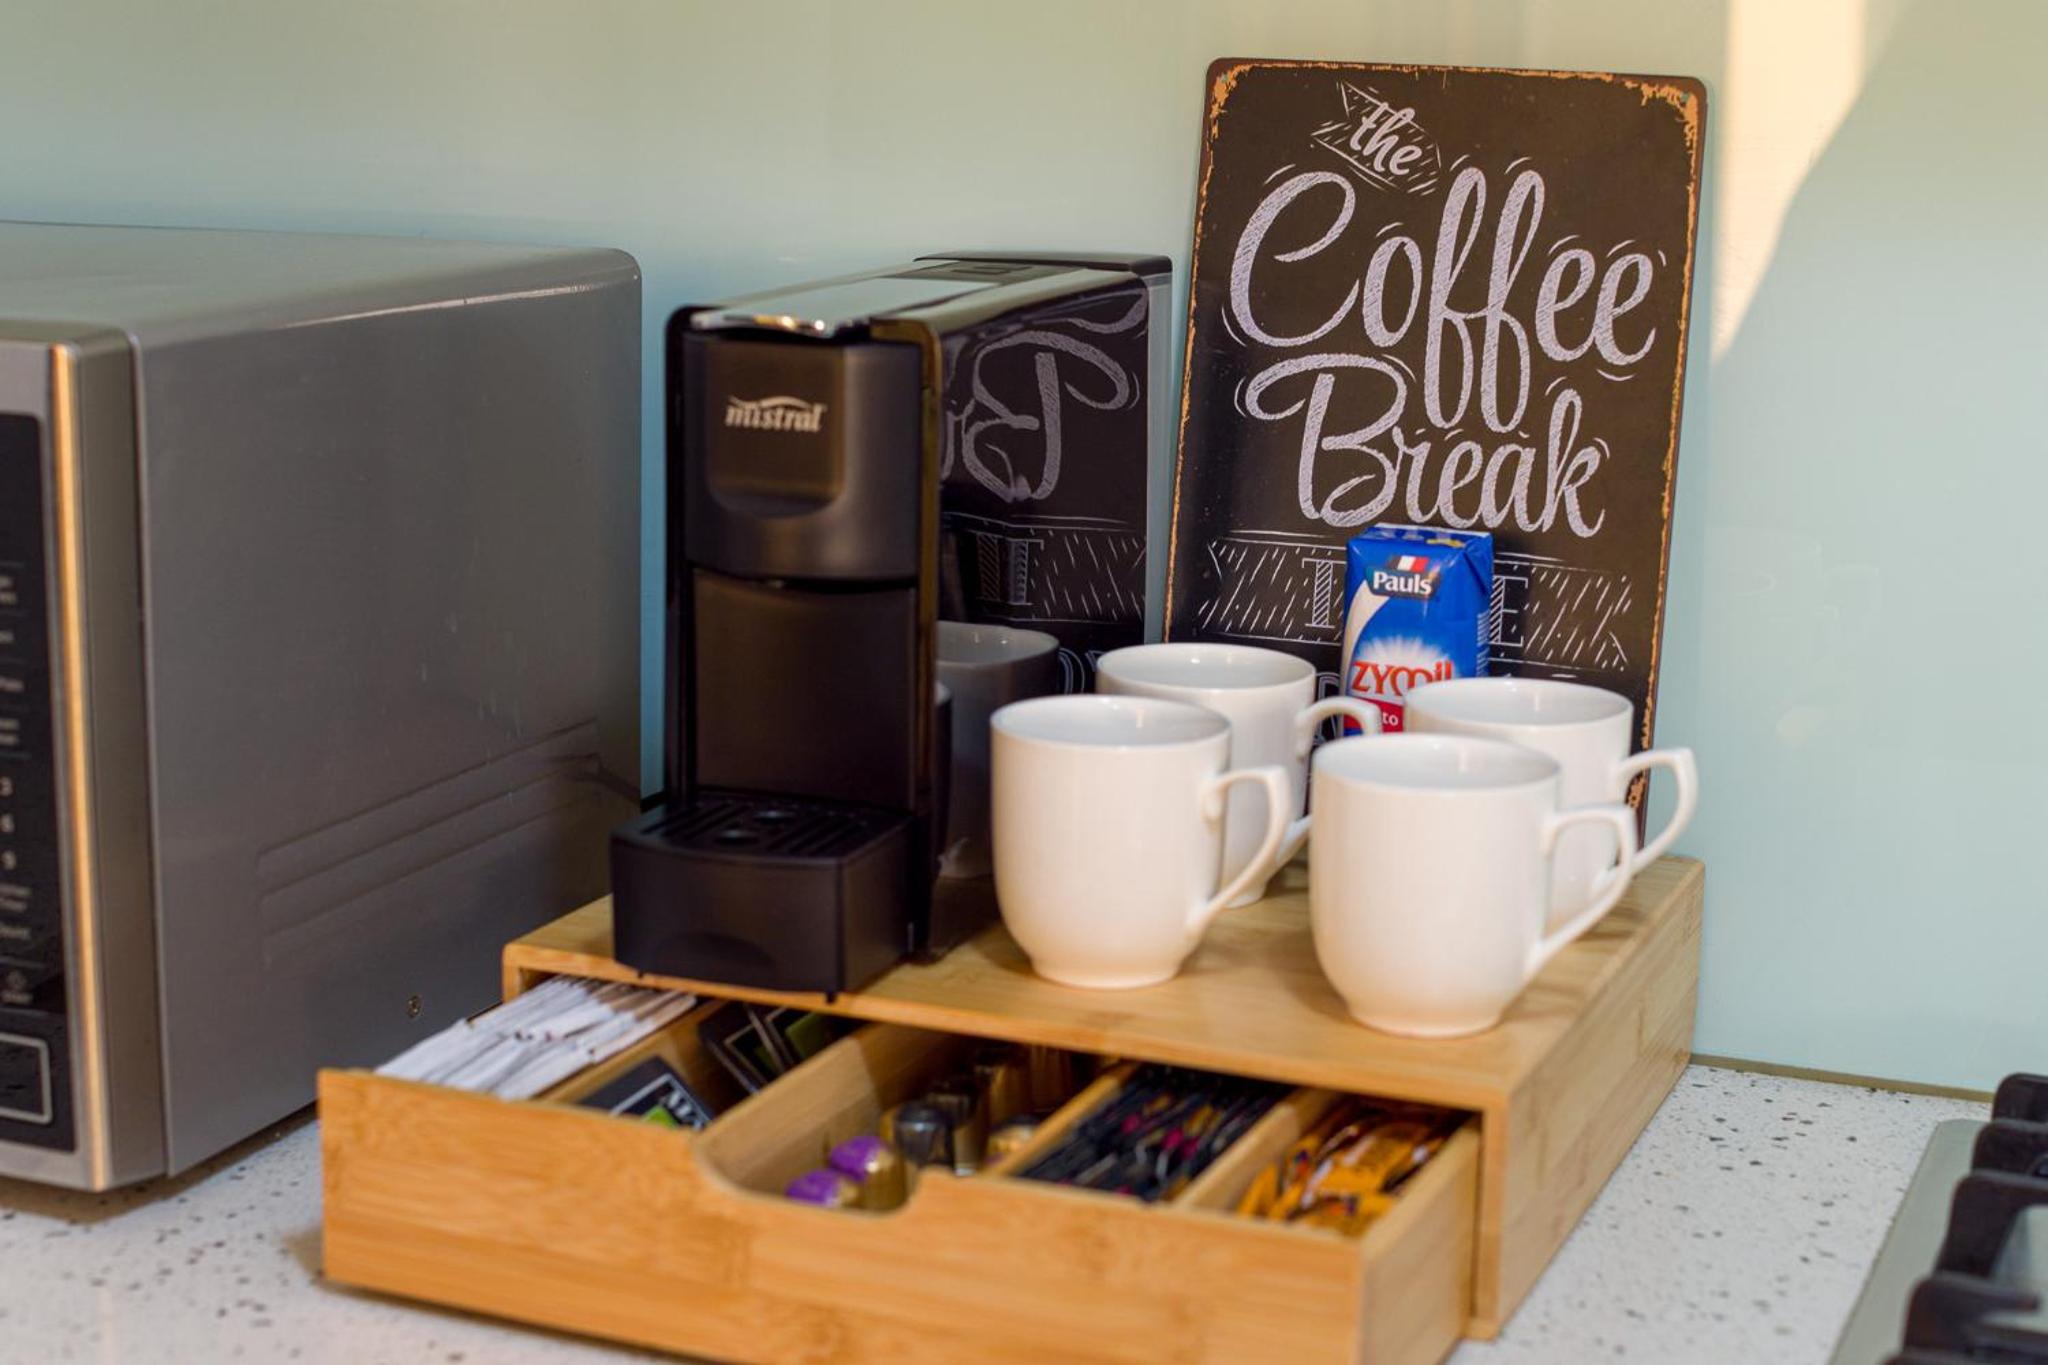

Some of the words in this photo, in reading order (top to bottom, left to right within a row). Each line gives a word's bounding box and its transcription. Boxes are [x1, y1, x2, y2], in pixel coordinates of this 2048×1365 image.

[1350, 102, 1423, 175] the
[1230, 166, 1657, 433] Coffee
[726, 400, 822, 433] mistral
[1245, 353, 1605, 538] Break
[1373, 571, 1433, 595] Pauls
[1382, 711, 1399, 726] to
